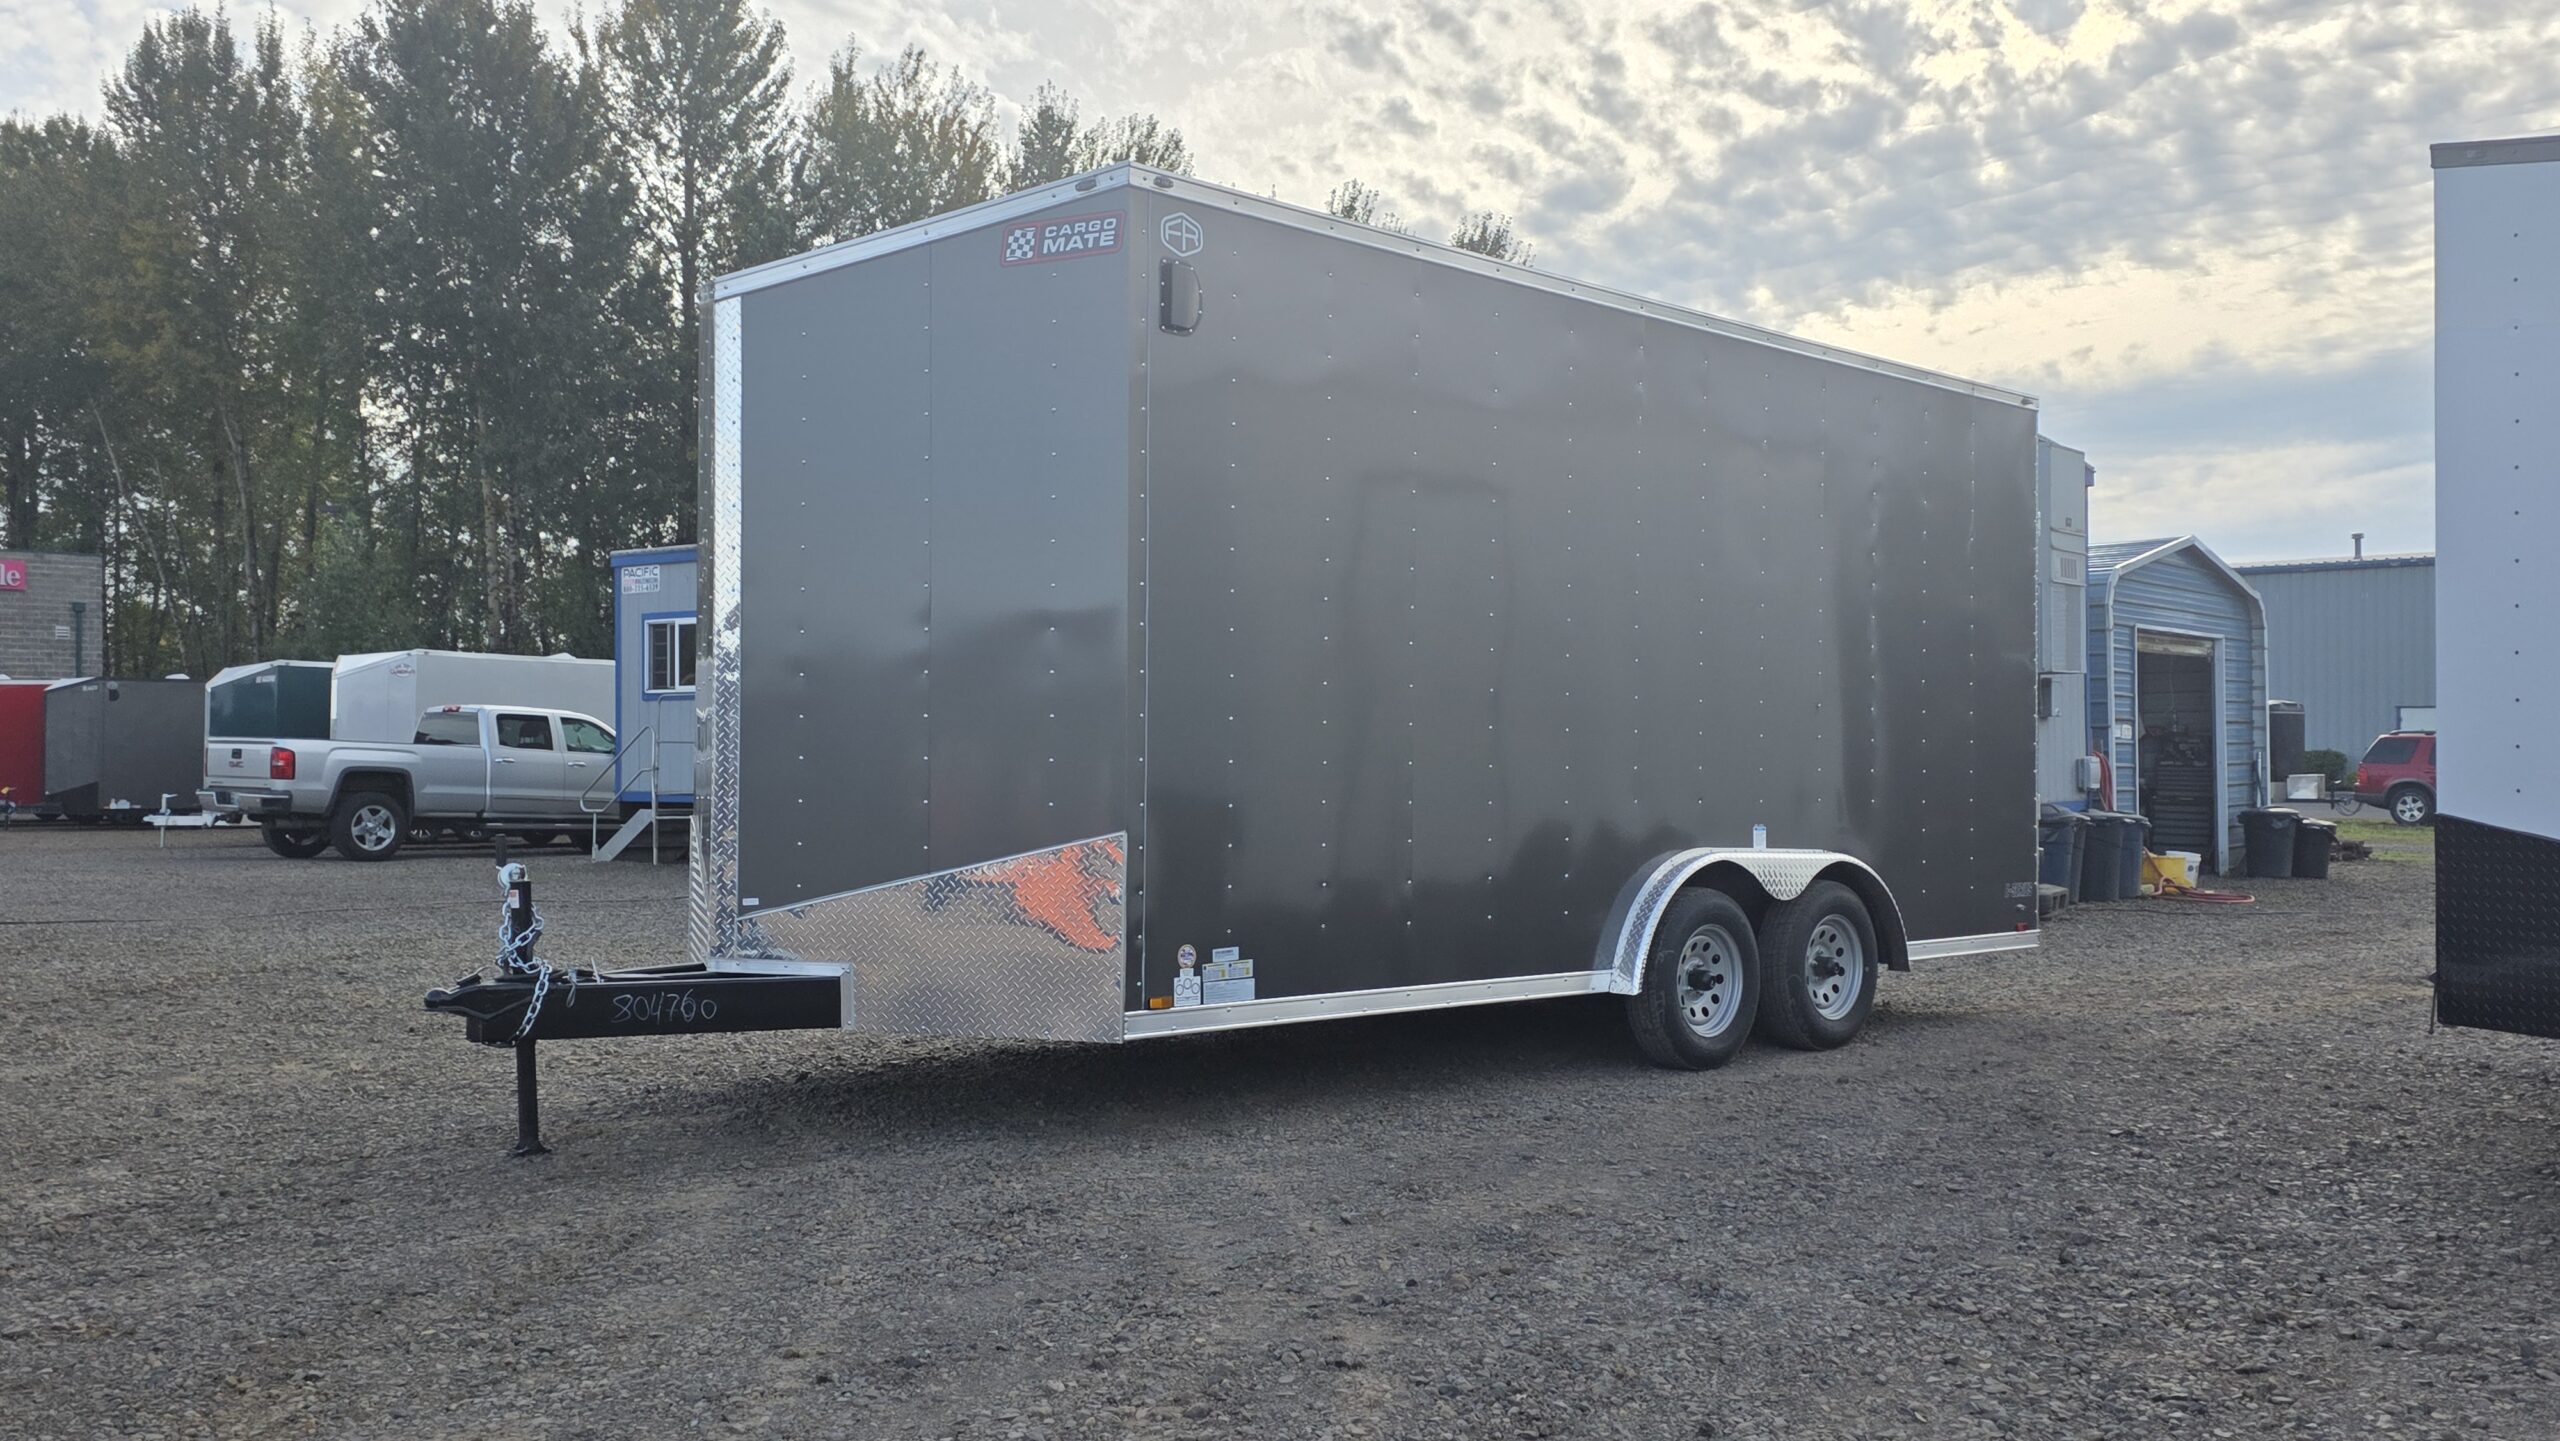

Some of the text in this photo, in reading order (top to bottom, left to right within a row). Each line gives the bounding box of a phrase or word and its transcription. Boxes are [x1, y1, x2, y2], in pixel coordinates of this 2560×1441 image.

[1045, 218, 1117, 237] CARGO
[1043, 230, 1115, 254] MATE
[623, 566, 659, 578] PACIFIC
[611, 988, 717, 1025] 804760
